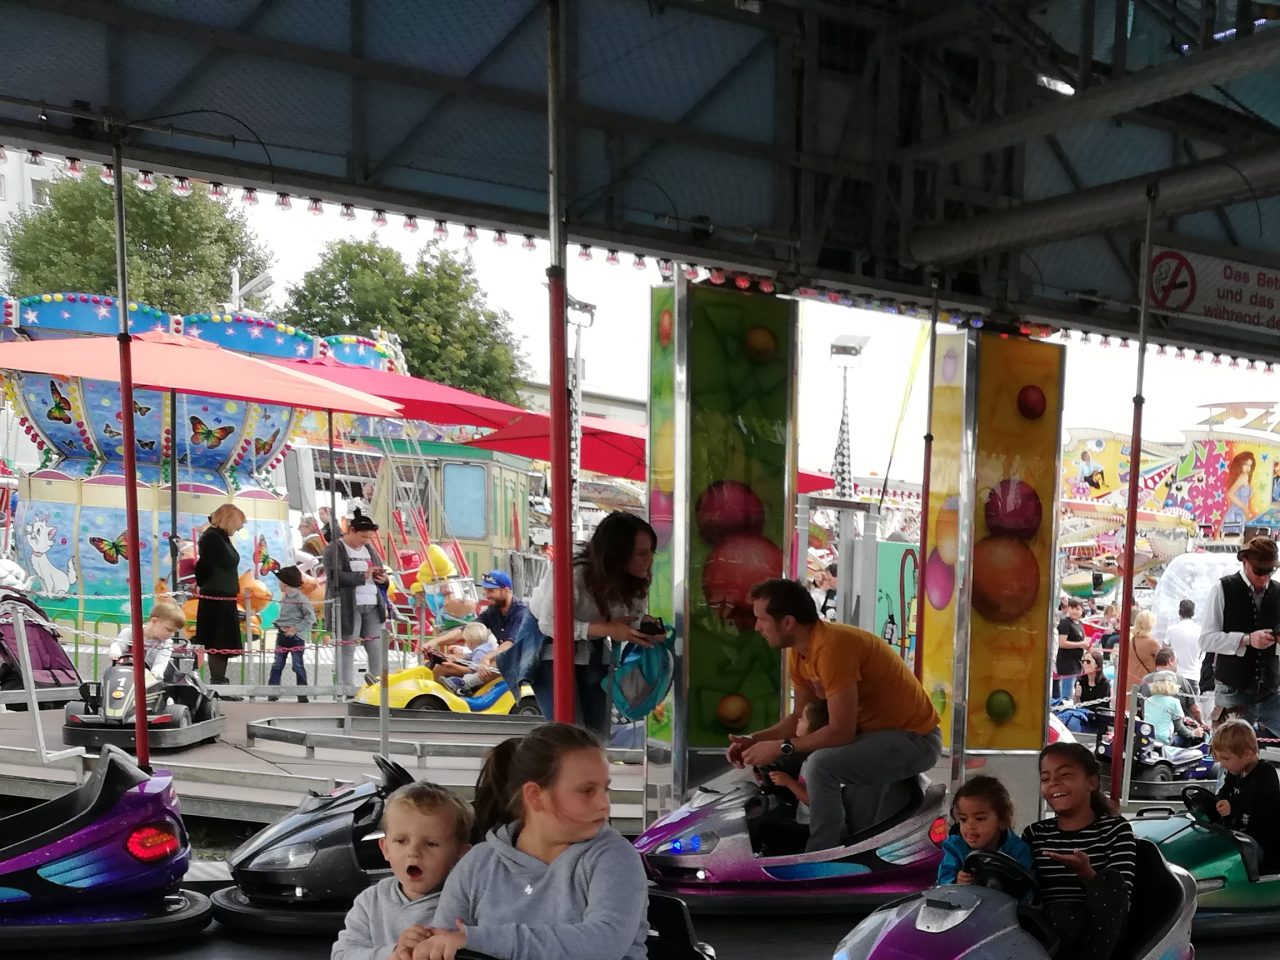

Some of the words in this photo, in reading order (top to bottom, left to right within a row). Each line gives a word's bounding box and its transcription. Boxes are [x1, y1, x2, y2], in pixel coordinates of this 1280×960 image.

[1223, 264, 1250, 284] Das
[1217, 287, 1243, 303] und
[1249, 292, 1274, 310] das
[1203, 303, 1260, 326] während
